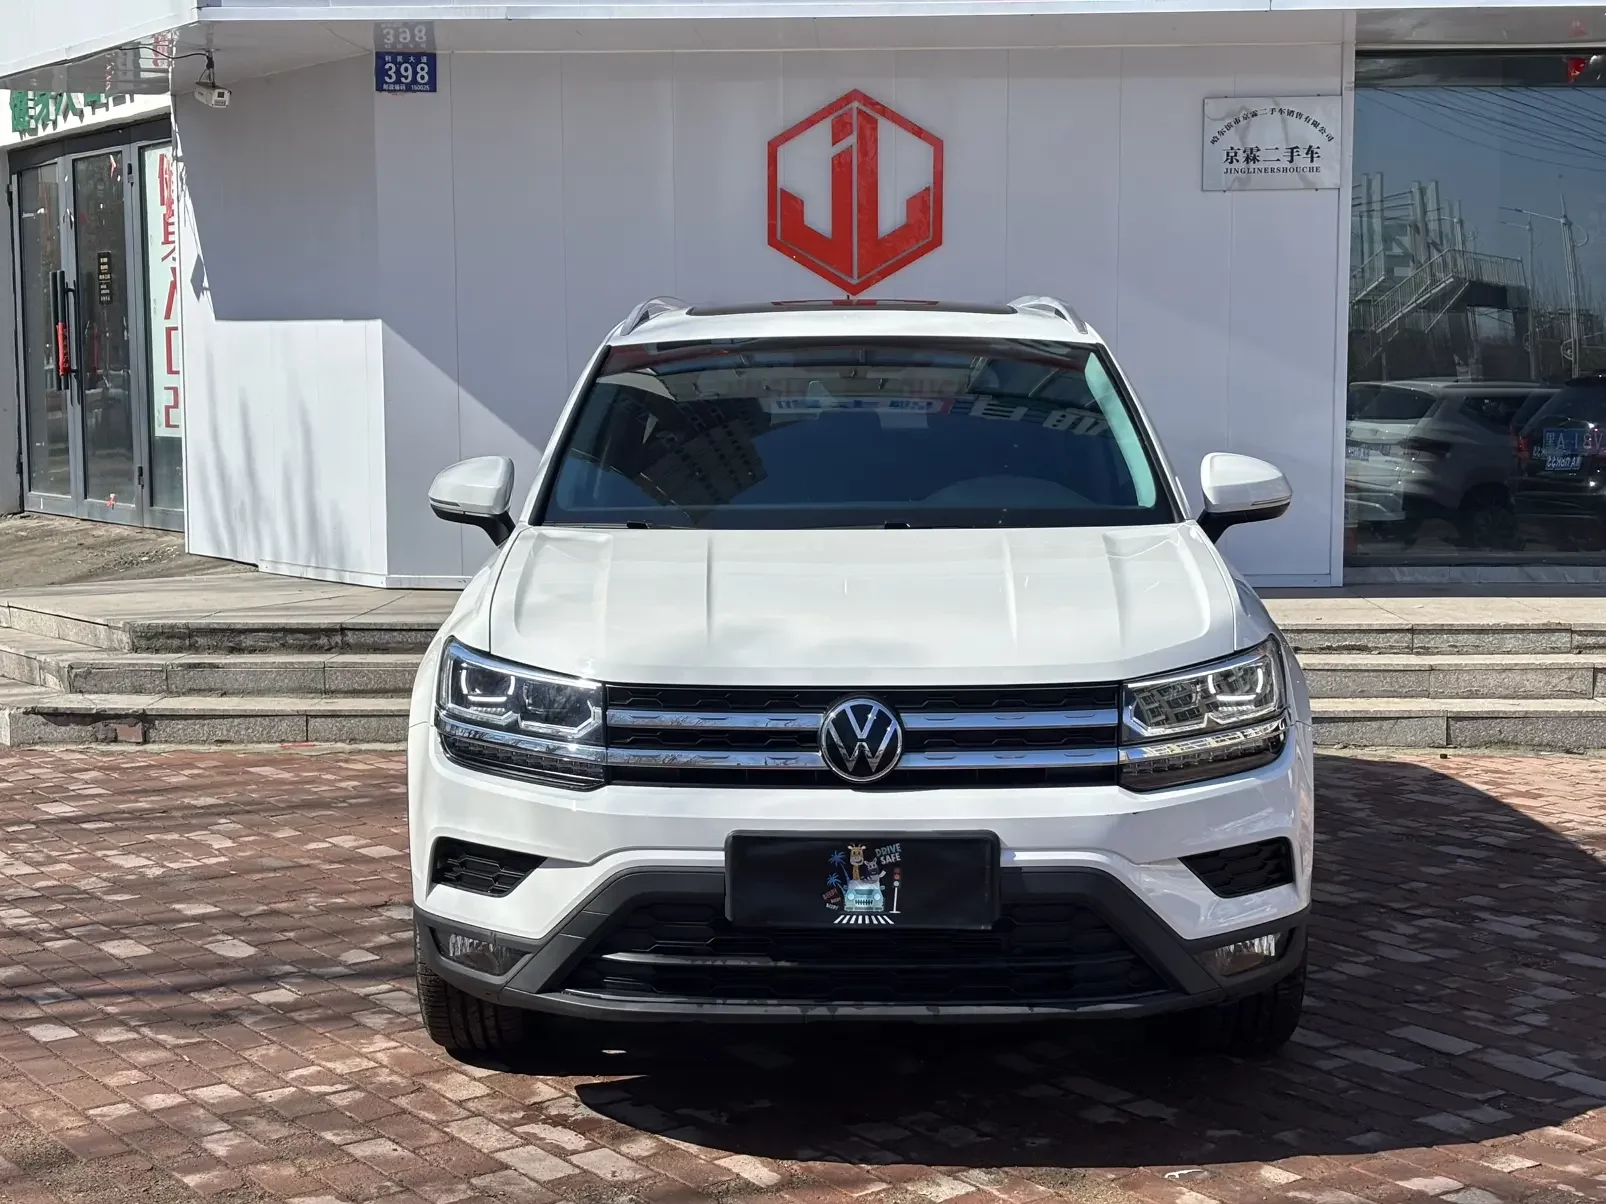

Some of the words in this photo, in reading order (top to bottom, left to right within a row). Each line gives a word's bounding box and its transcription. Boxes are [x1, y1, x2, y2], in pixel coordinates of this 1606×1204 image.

[384, 63, 429, 83] 398
[1210, 107, 1334, 145] 哈尔滨市京霖二手车销售有限公司
[1223, 145, 1322, 164] 京霖二手车
[1224, 166, 1321, 175] JINGLINERSHOUCHE
[875, 843, 902, 857] DRIVE
[880, 852, 901, 865] SAFE
